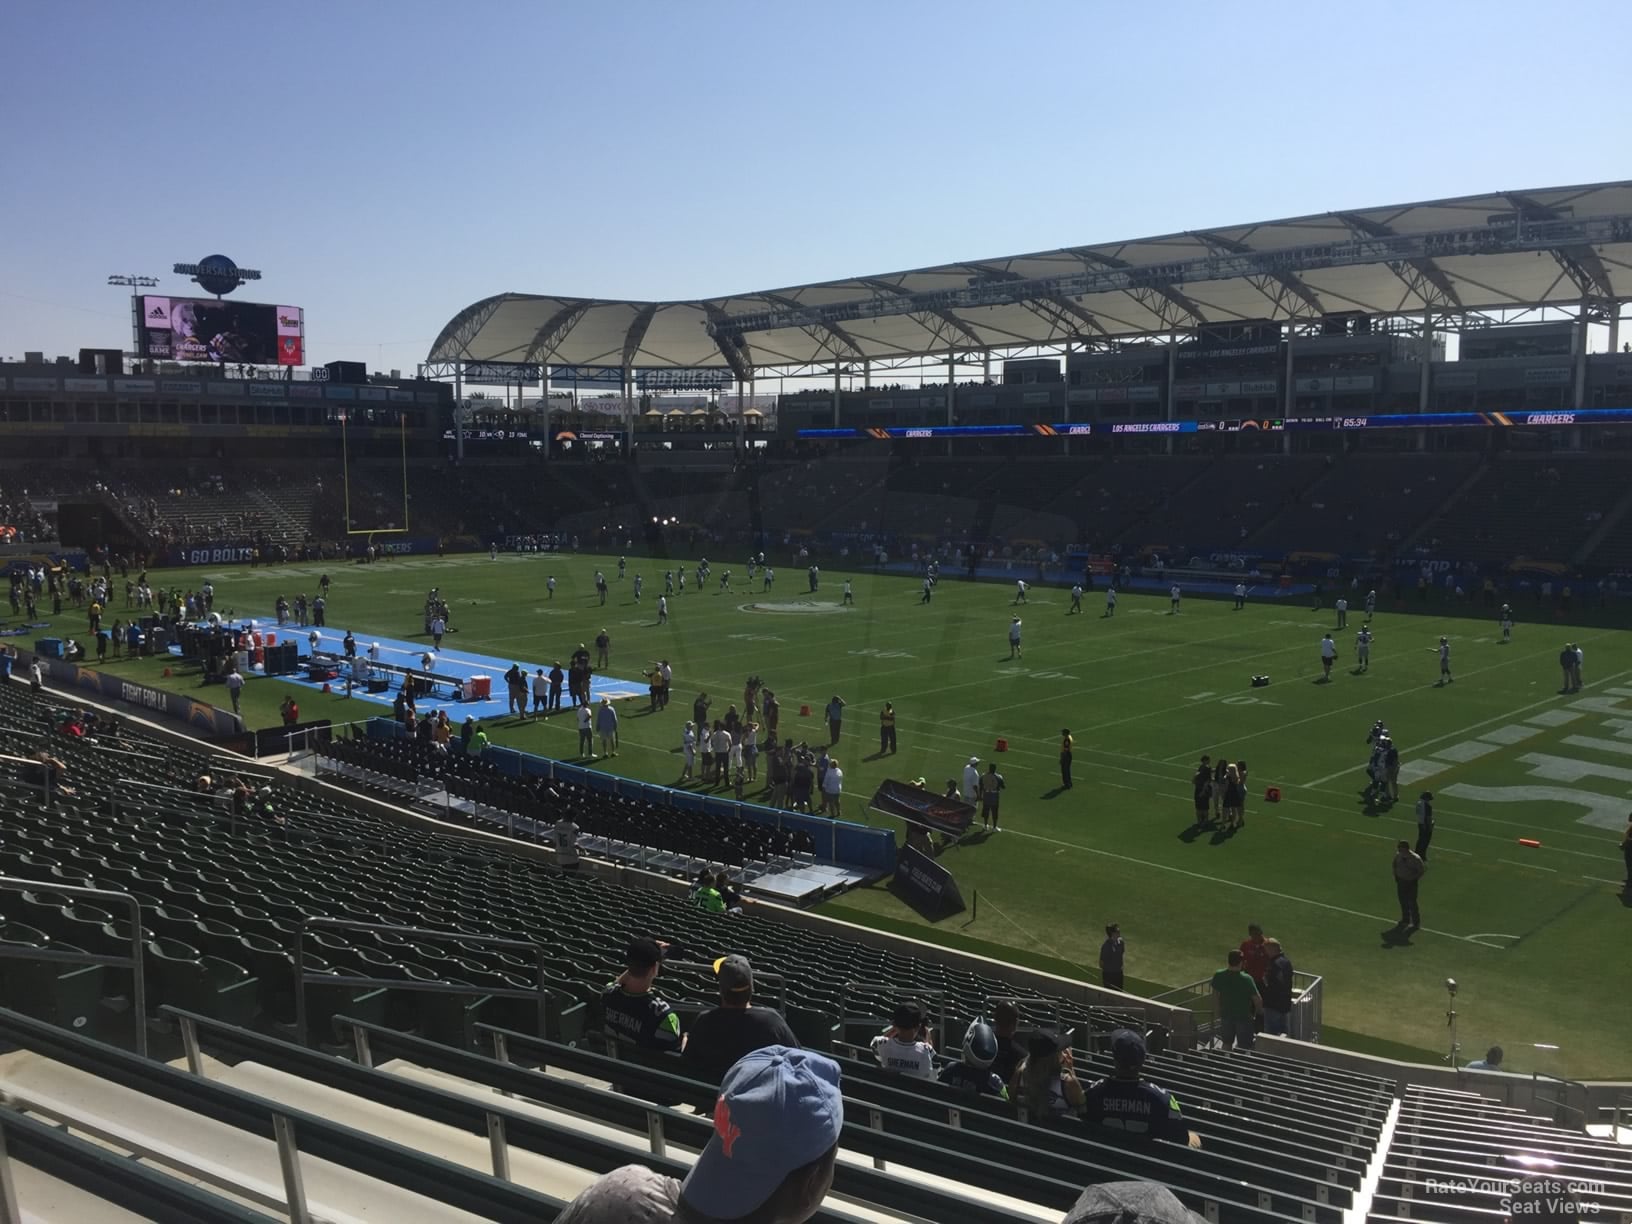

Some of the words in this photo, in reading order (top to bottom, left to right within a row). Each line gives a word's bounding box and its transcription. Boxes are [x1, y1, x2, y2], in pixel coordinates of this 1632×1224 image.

[176, 263, 228, 277] UNIVERSAL
[1343, 418, 1367, 427] 65:34
[1527, 413, 1576, 425] CHARGERS
[905, 430, 932, 438] CHARGERS
[1112, 424, 1125, 433] LOS
[1125, 423, 1150, 432] ANGELES
[1150, 423, 1180, 432] CHARGERS
[191, 550, 209, 563] GO
[212, 548, 253, 562] BOLTS
[121, 682, 142, 704] FIGHT
[143, 688, 157, 708] FOR
[157, 692, 168, 712] LA
[1103, 1097, 1151, 1115] SHERMAN
